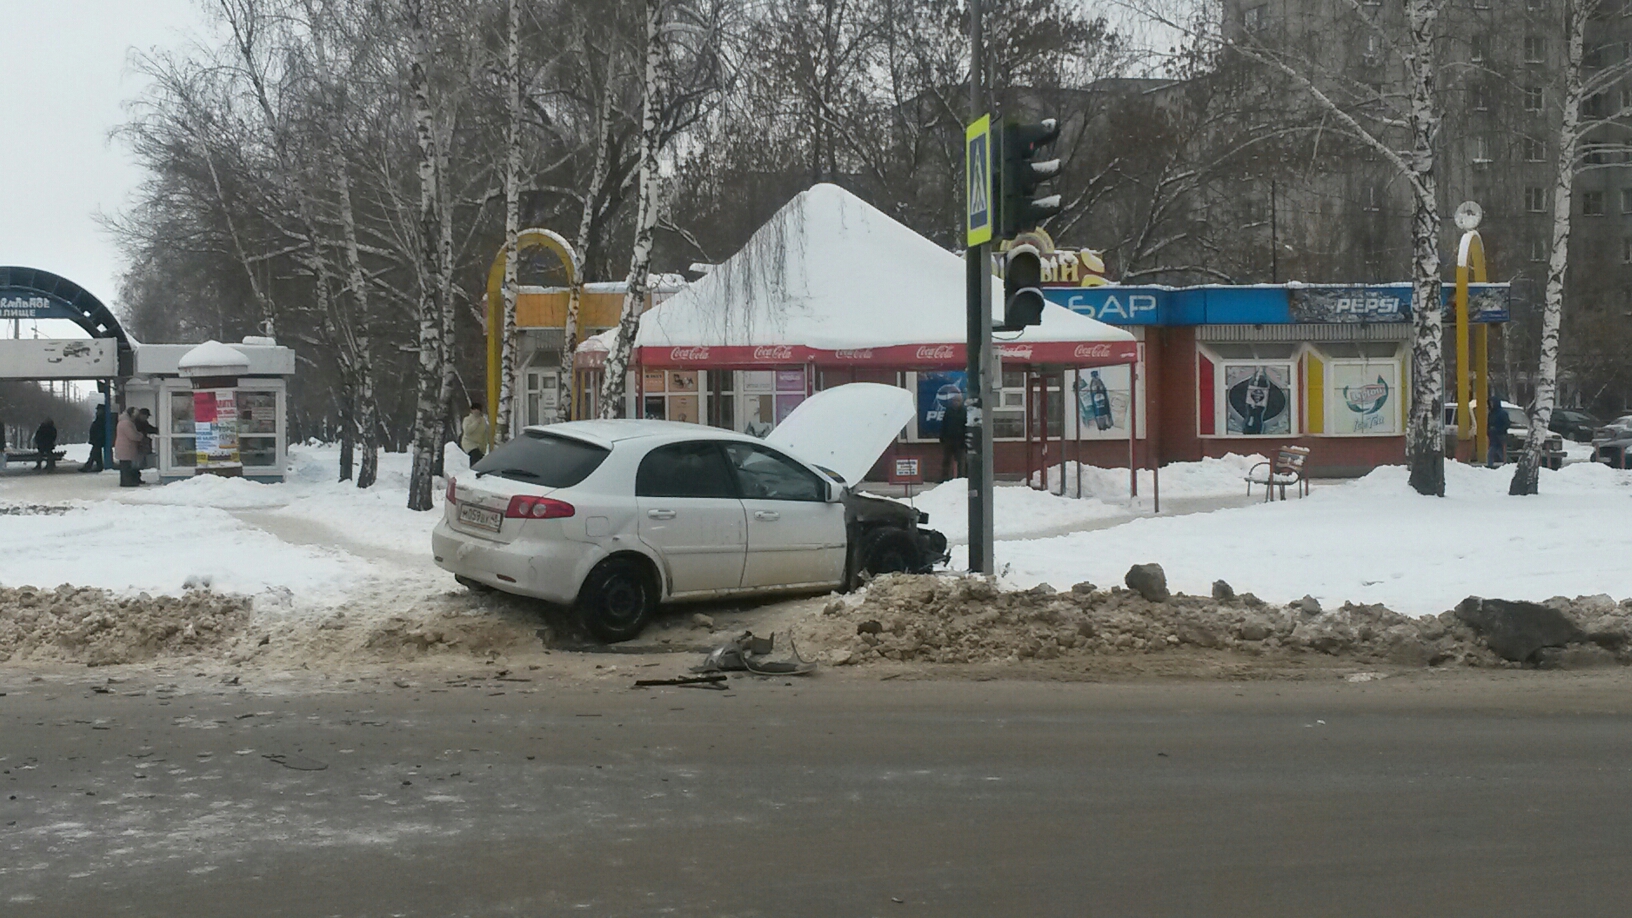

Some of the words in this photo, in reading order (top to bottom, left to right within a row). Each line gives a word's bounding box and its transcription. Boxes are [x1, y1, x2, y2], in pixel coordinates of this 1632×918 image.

[1068, 295, 1157, 318] БАР
[1336, 298, 1400, 313] PEPSI
[0, 309, 36, 317] ЛИЩЕ
[926, 410, 946, 421] PE
